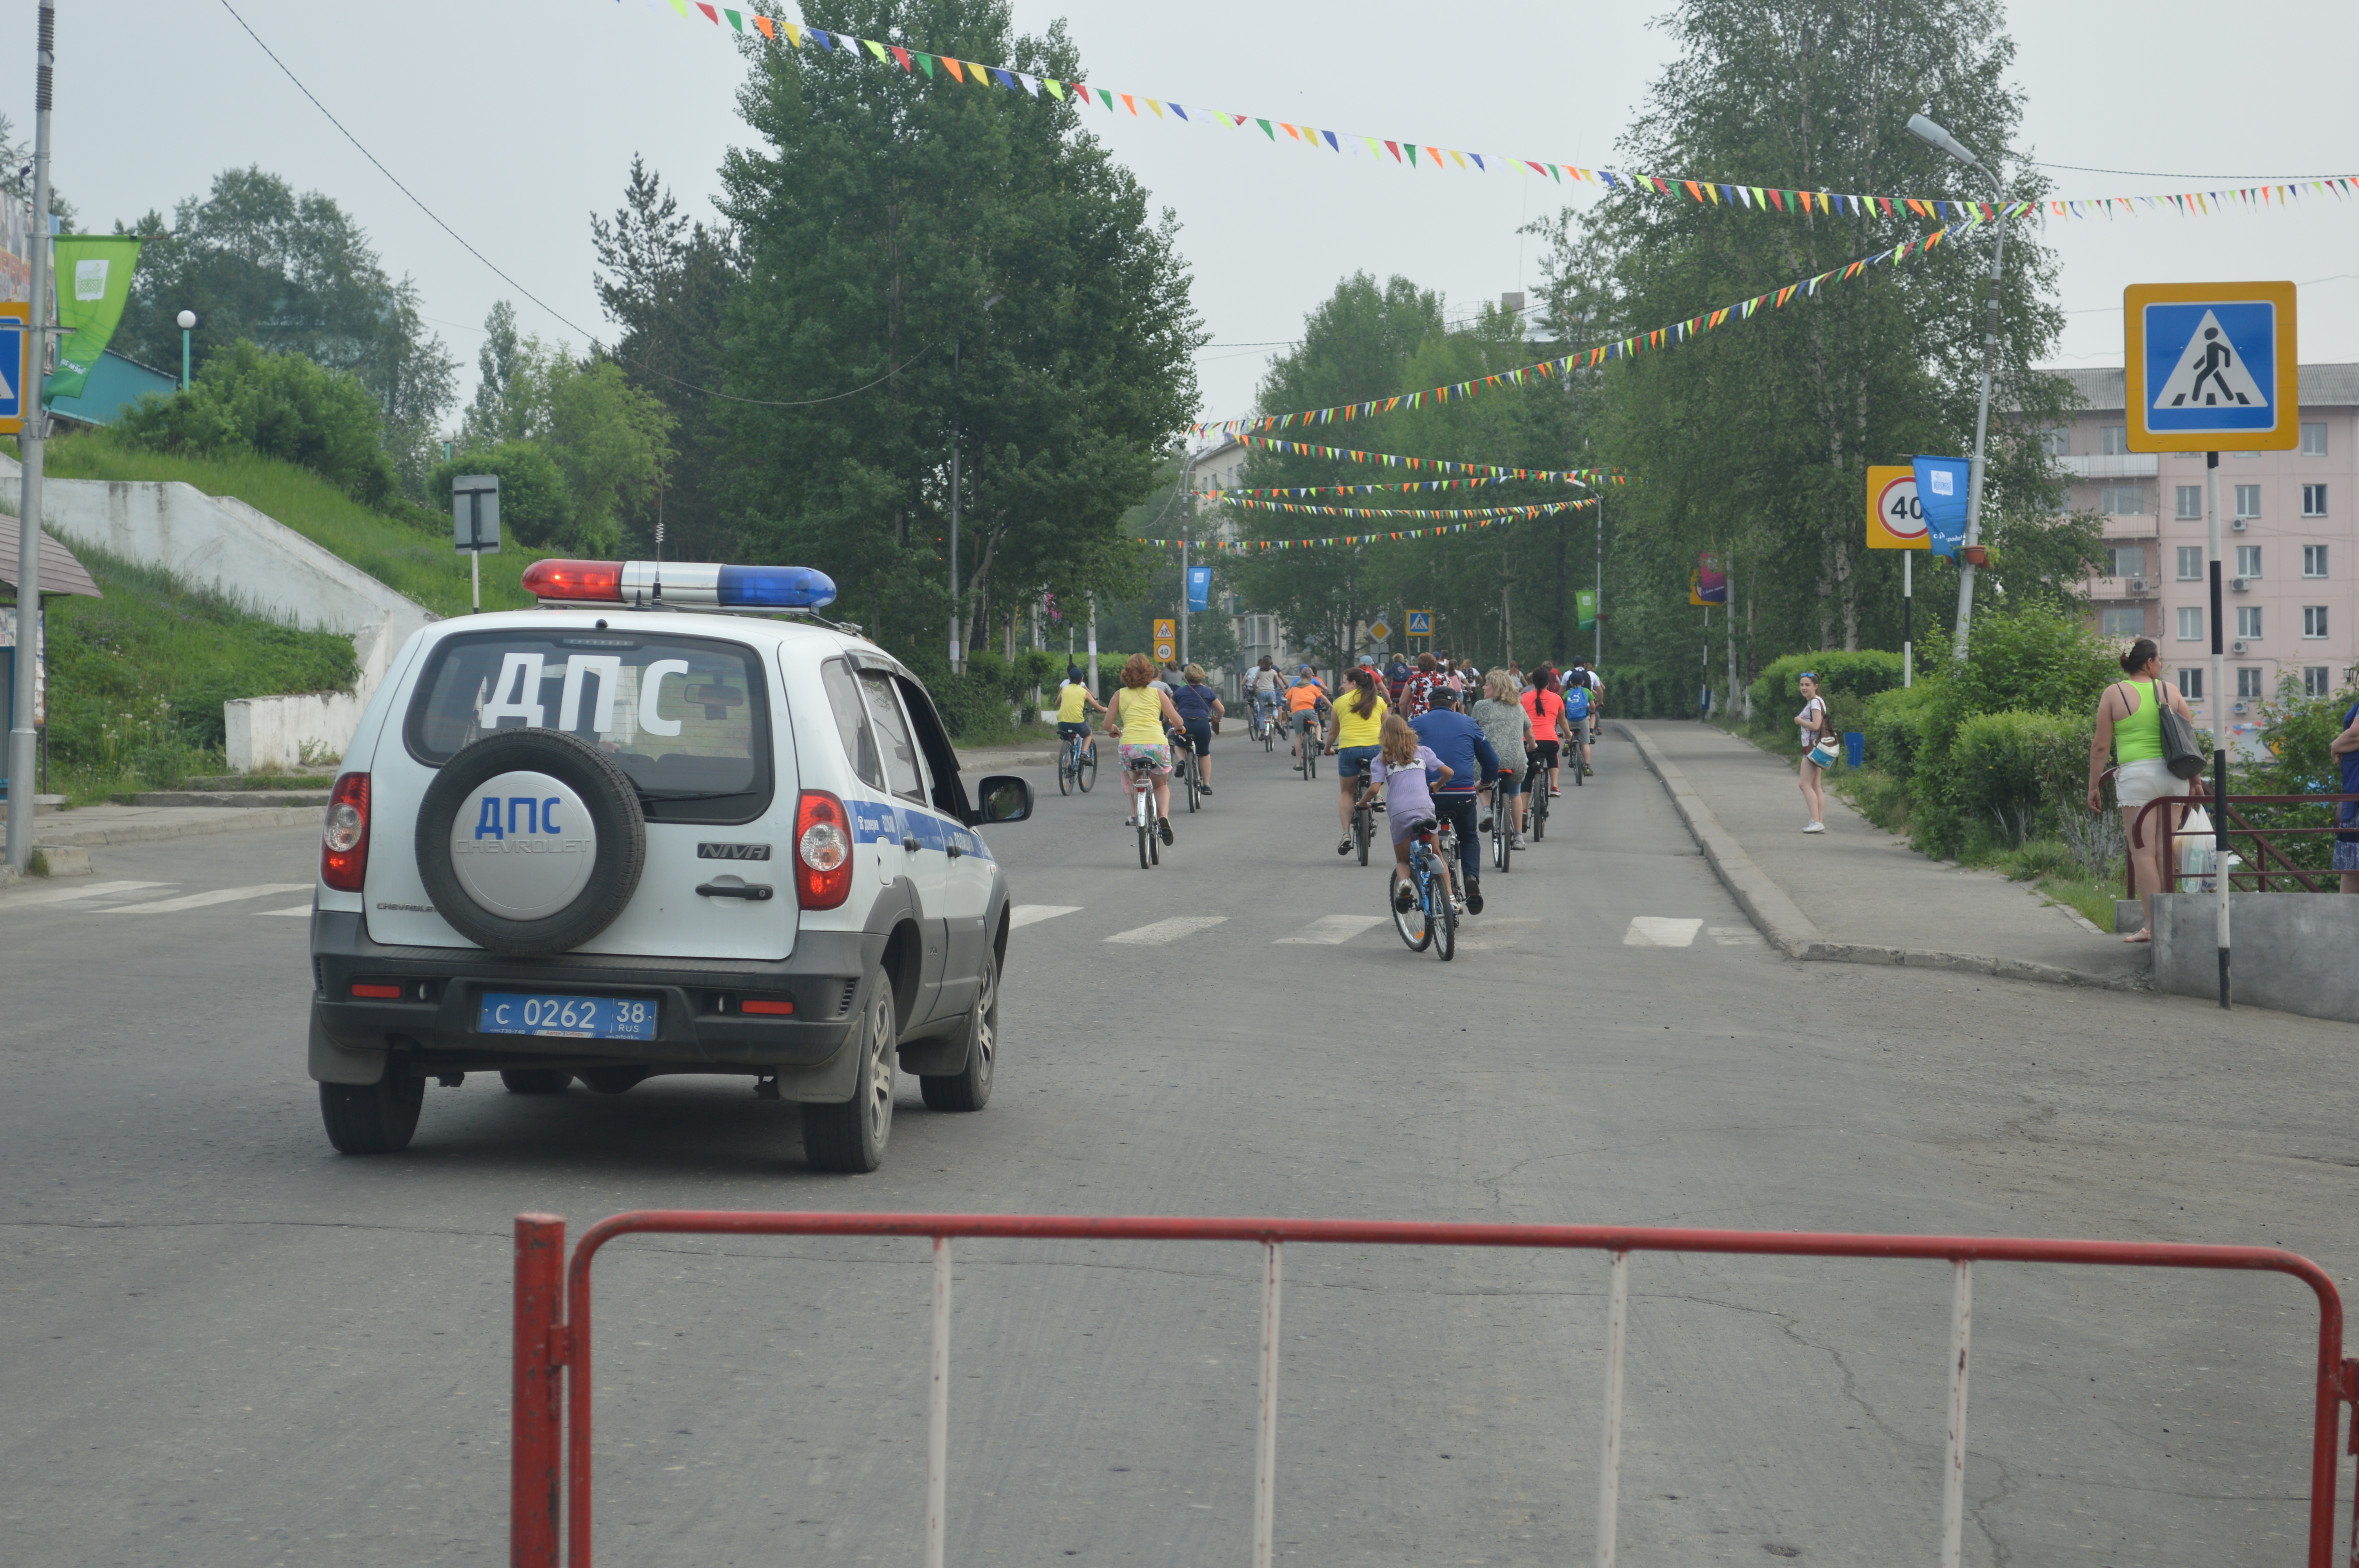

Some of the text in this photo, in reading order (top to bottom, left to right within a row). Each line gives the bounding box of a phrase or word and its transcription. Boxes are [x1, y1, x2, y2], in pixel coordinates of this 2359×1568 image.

[1891, 496, 1923, 519] 40
[481, 653, 689, 737] ДПС
[475, 797, 561, 840] ДПС
[454, 838, 591, 854] CHEVROLET
[701, 844, 767, 859] NIVA
[524, 999, 596, 1029] 0262
[616, 1002, 644, 1024] 38
[618, 1024, 639, 1033] RUS
